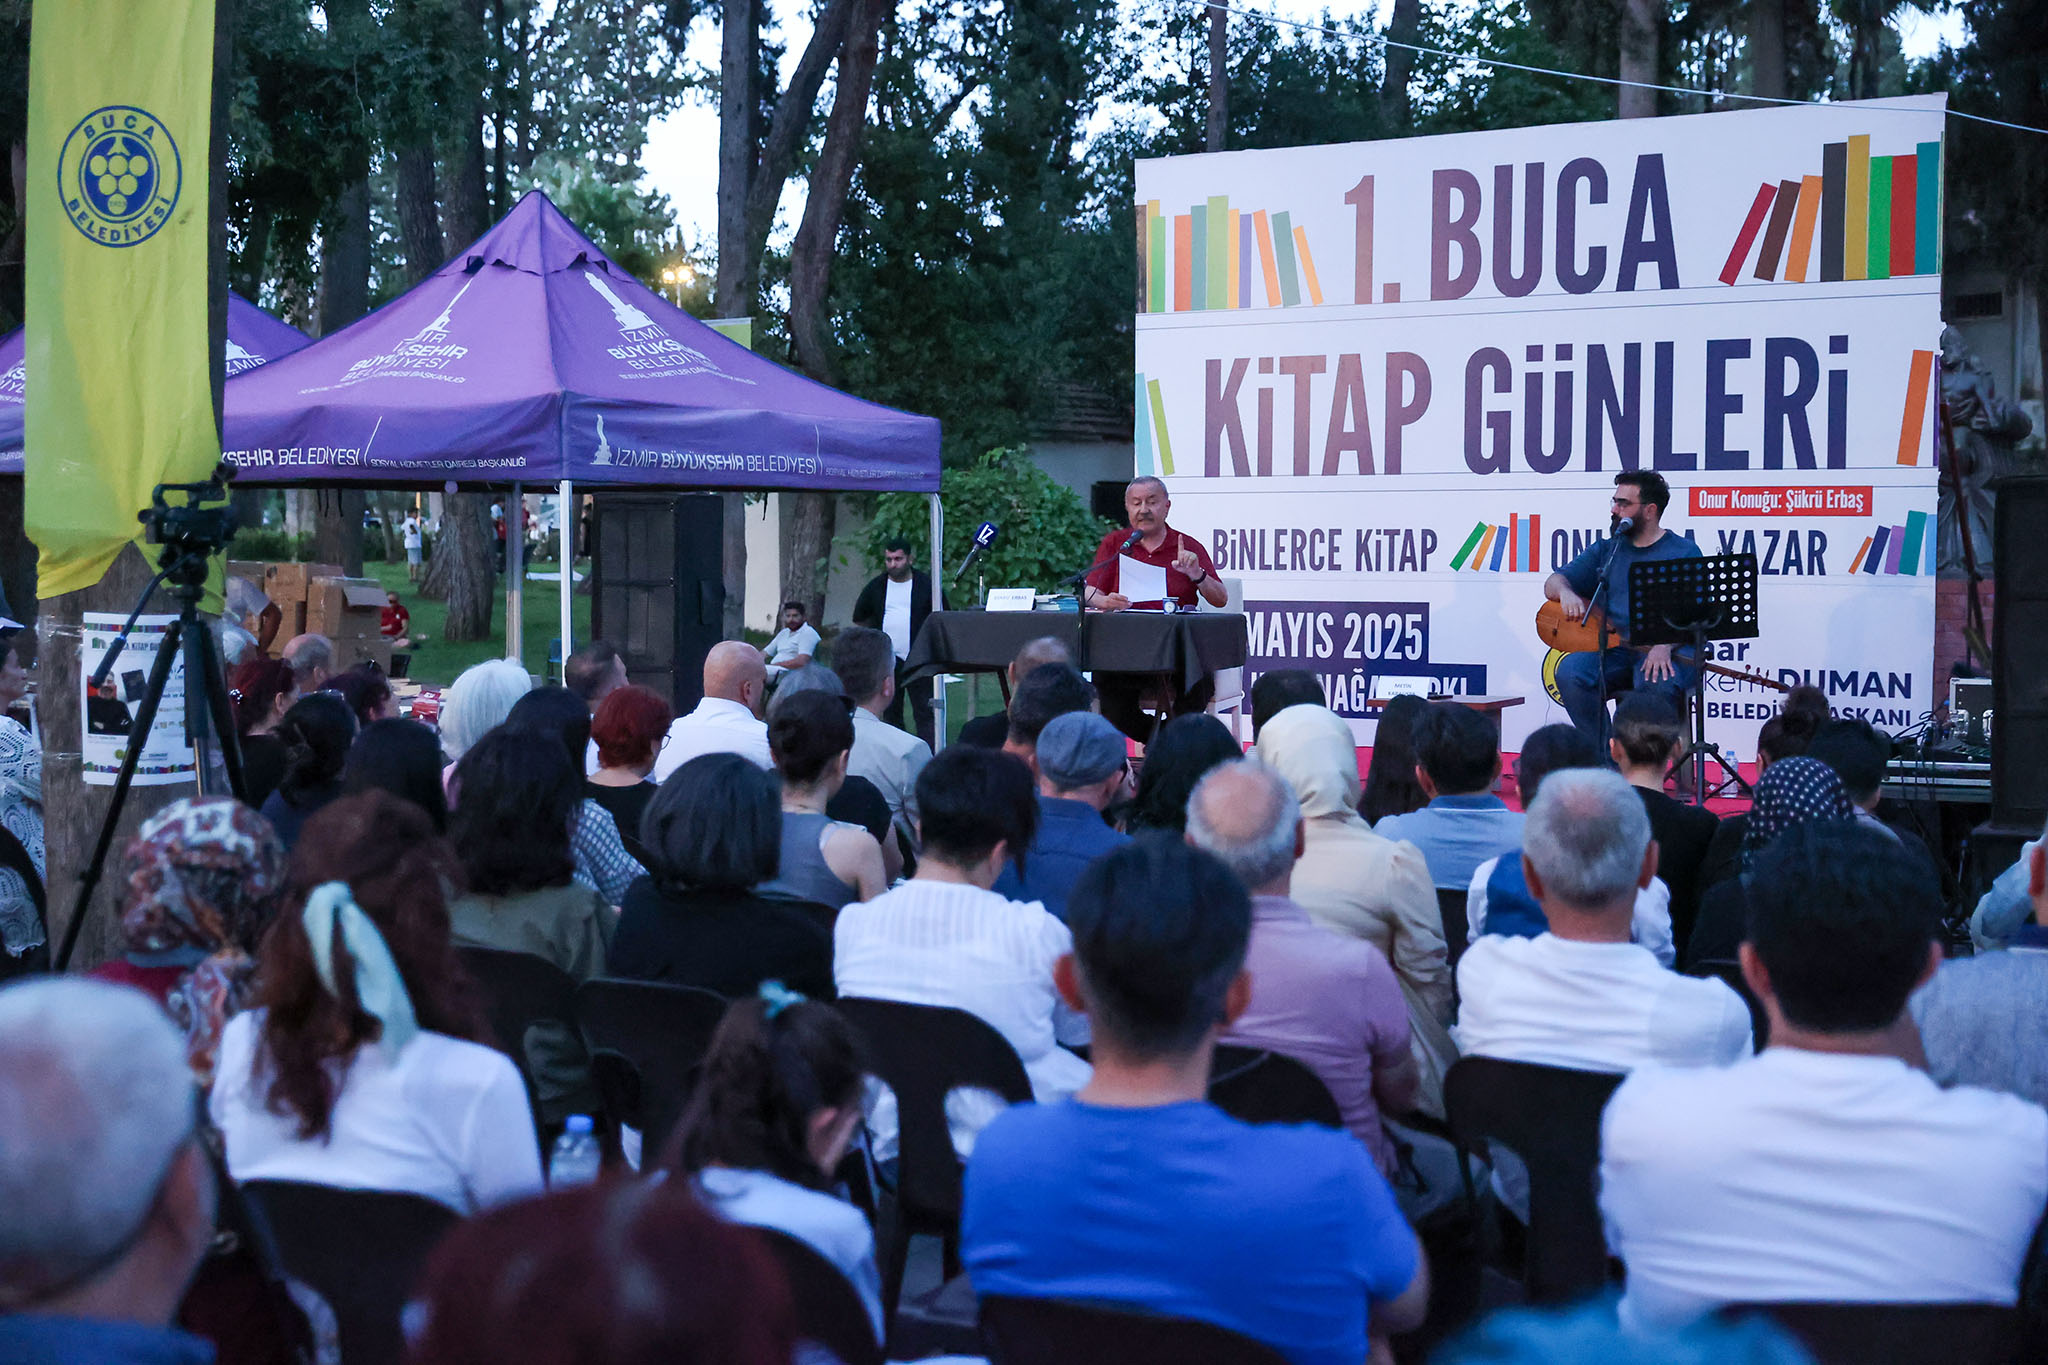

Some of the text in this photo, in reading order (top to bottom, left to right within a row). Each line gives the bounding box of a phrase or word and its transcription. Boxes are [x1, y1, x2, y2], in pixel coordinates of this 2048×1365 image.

[83, 114, 155, 140] BUCA
[67, 195, 171, 242] BELEDİYESİ
[1344, 153, 1680, 305] 1. BUCA
[1204, 334, 1850, 478] KİTAP GÜNLERİ
[278, 445, 360, 466] BELEDİYESİ
[616, 447, 658, 468] İZMİR
[661, 451, 744, 473] BÜYÜKŞEHİR
[747, 453, 817, 475] BELEDİYESİ
[1699, 489, 1864, 513] Onur Konuğu: Şükrü Erbaş
[1213, 528, 1438, 572] BİNLERCE KİTAP
[1717, 529, 1828, 576] YAZAR
[1343, 612, 1423, 661] 2025
[1706, 699, 1780, 720] BELEDİ
